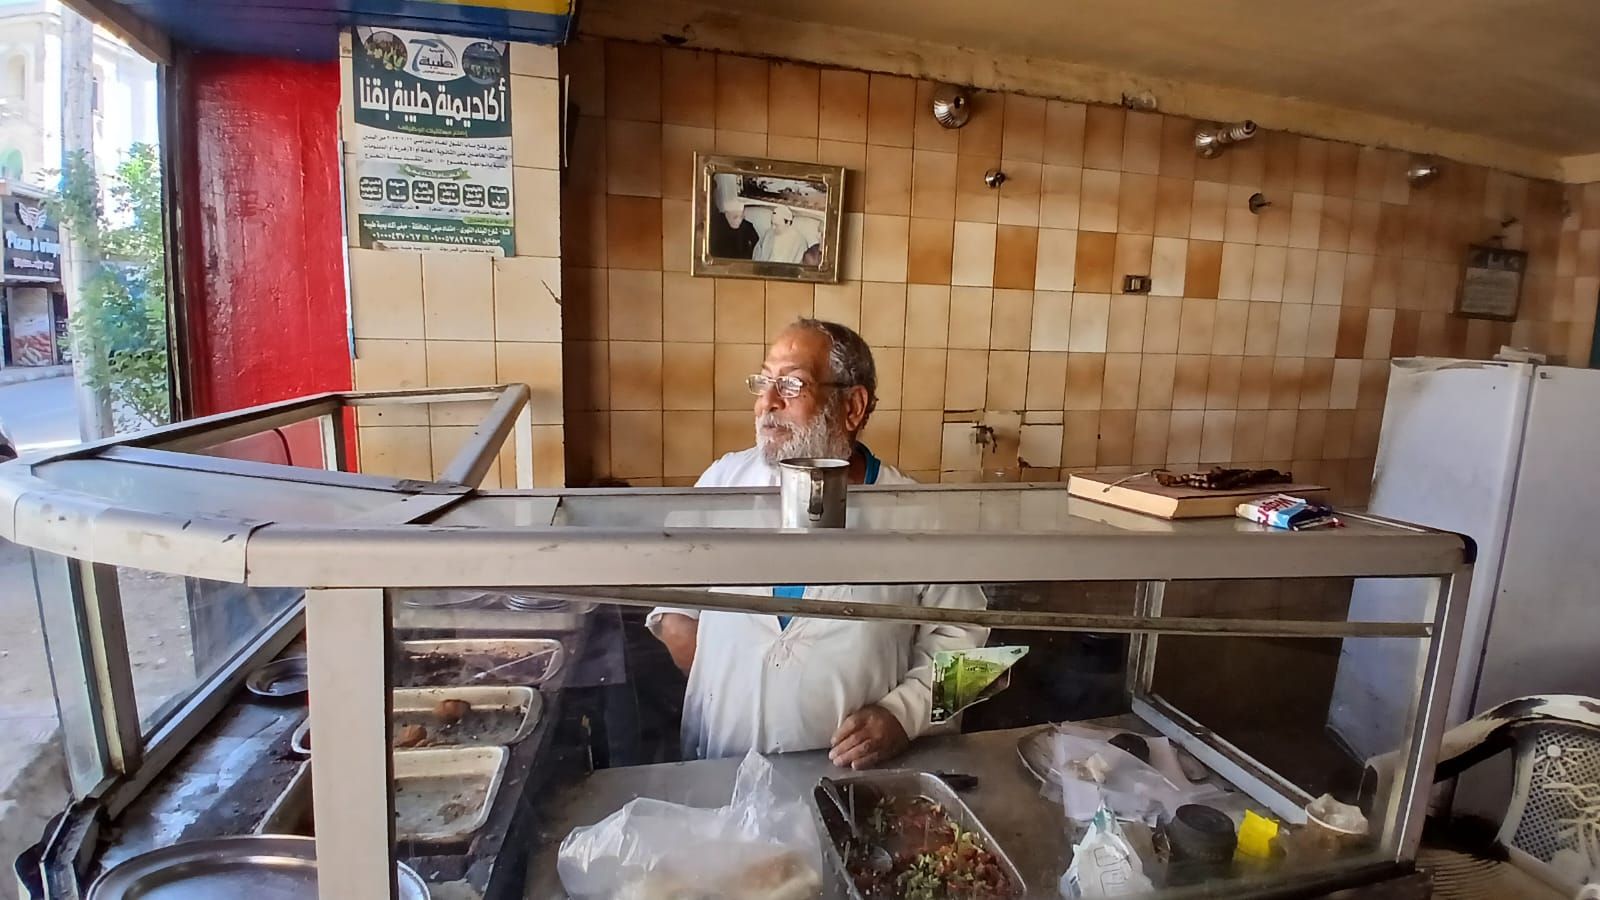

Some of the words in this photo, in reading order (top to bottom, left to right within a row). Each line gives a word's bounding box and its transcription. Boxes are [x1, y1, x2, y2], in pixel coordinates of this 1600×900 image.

[419, 54, 453, 69] طيبة
[359, 77, 390, 121] بقنا
[392, 80, 433, 123] طيبة
[435, 77, 506, 128] أكاديمية
[363, 219, 376, 230] طيبة
